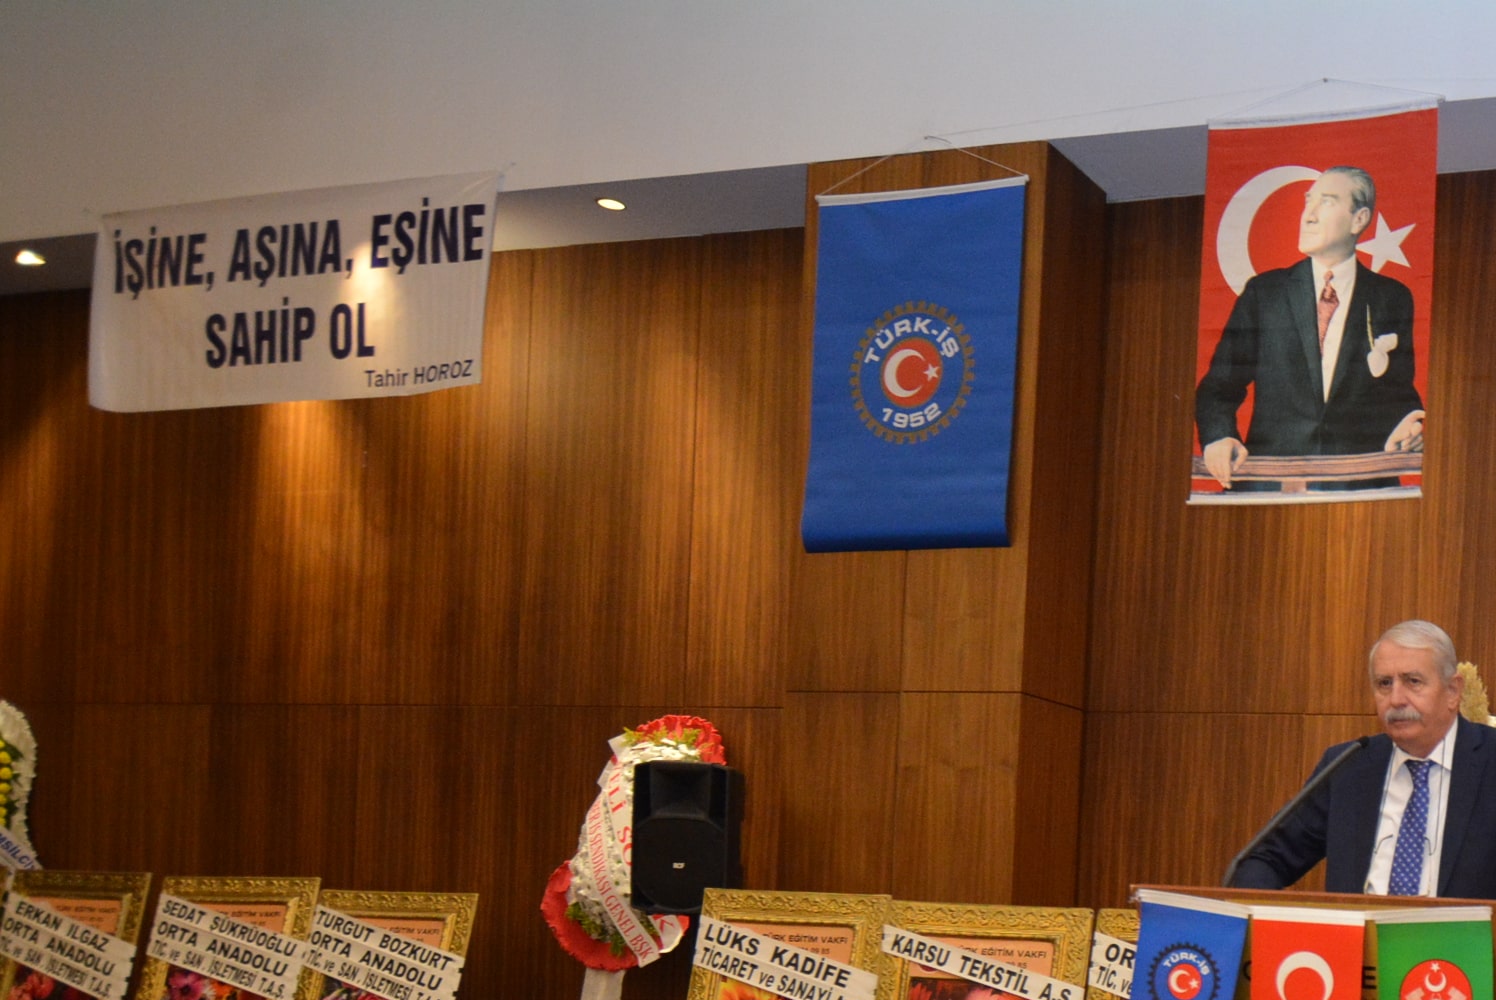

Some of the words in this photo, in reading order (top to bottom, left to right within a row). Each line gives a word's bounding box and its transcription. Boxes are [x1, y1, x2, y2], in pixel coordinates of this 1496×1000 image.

[114, 226, 215, 300] İŞİNE,
[227, 219, 353, 287] AŞINA,
[370, 197, 486, 274] EŞİNE
[205, 297, 315, 368] SAHİP
[330, 302, 375, 359] OL
[864, 317, 960, 363] TÜRK-İŞ
[365, 370, 408, 388] Tahir
[413, 359, 473, 383] HOROZ
[882, 403, 941, 428] 1952
[16, 901, 63, 931] ERKAN
[163, 900, 206, 925] SEDAT
[210, 914, 298, 957] ŞÜKRÜOĞLU
[605, 895, 635, 937] GENEL
[3, 917, 39, 944] ORTA
[46, 937, 116, 976] ANADOLU
[157, 921, 199, 947] ORTA
[206, 939, 288, 977] ANADOLU
[311, 931, 352, 958] ORTA
[359, 950, 443, 991] ANADOLU
[316, 910, 375, 942] TURGUT
[379, 934, 455, 972] BOZKURT
[704, 923, 761, 956] LÜKS
[770, 946, 851, 988] KADİFE
[821, 936, 848, 945] VAKFI
[1018, 950, 1047, 959] VAKFI
[1105, 943, 1136, 969] OR
[700, 945, 759, 981] TİCARET
[759, 971, 776, 988] ve
[891, 934, 951, 967] KARSU
[959, 955, 1029, 995] TEKSTİL
[1095, 964, 1117, 990] TİC.
